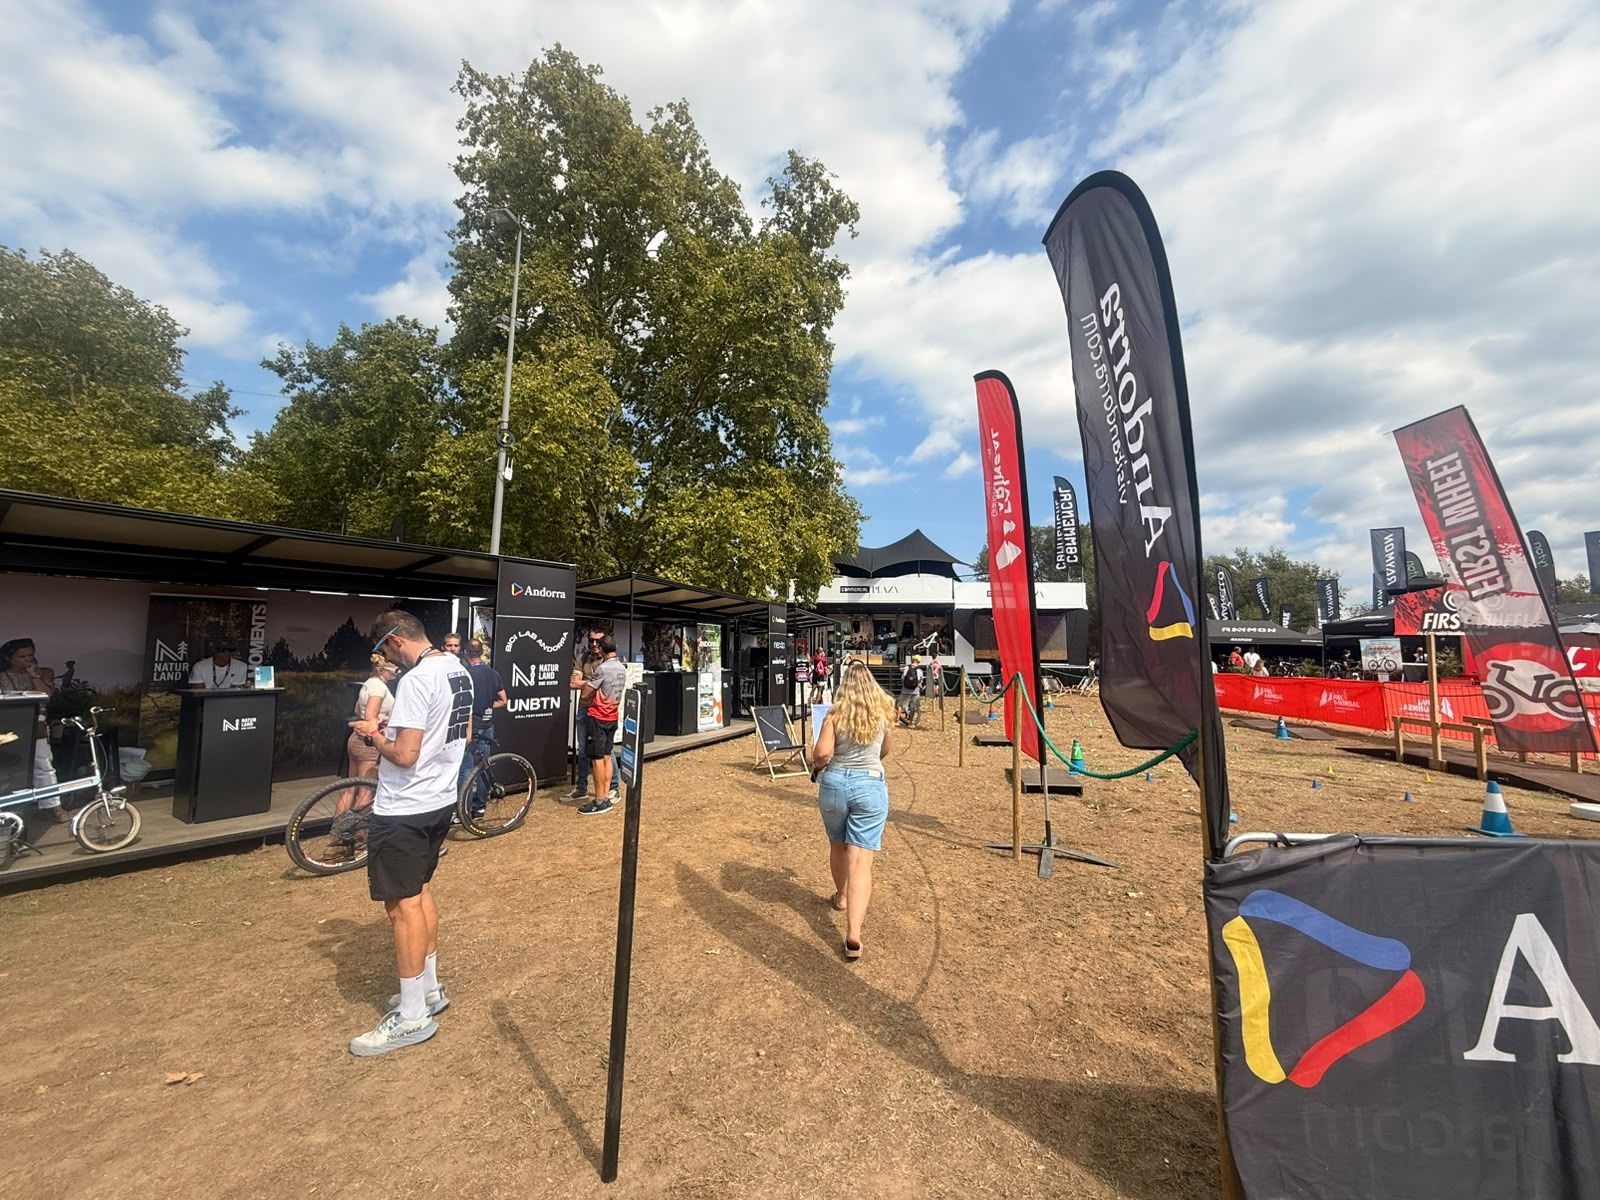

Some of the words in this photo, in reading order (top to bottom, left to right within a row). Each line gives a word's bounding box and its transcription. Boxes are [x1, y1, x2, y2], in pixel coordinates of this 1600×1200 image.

[524, 585, 566, 599] Andorra
[1423, 612, 1461, 630] FIRS
[505, 634, 518, 652] BICI
[518, 630, 538, 641] LAB
[536, 632, 569, 653] ANDORRA
[154, 662, 189, 672] NATUR
[538, 664, 559, 672] NATUR
[153, 671, 182, 681] LAND
[538, 671, 555, 680] LAND
[506, 696, 561, 712] UNBTN
